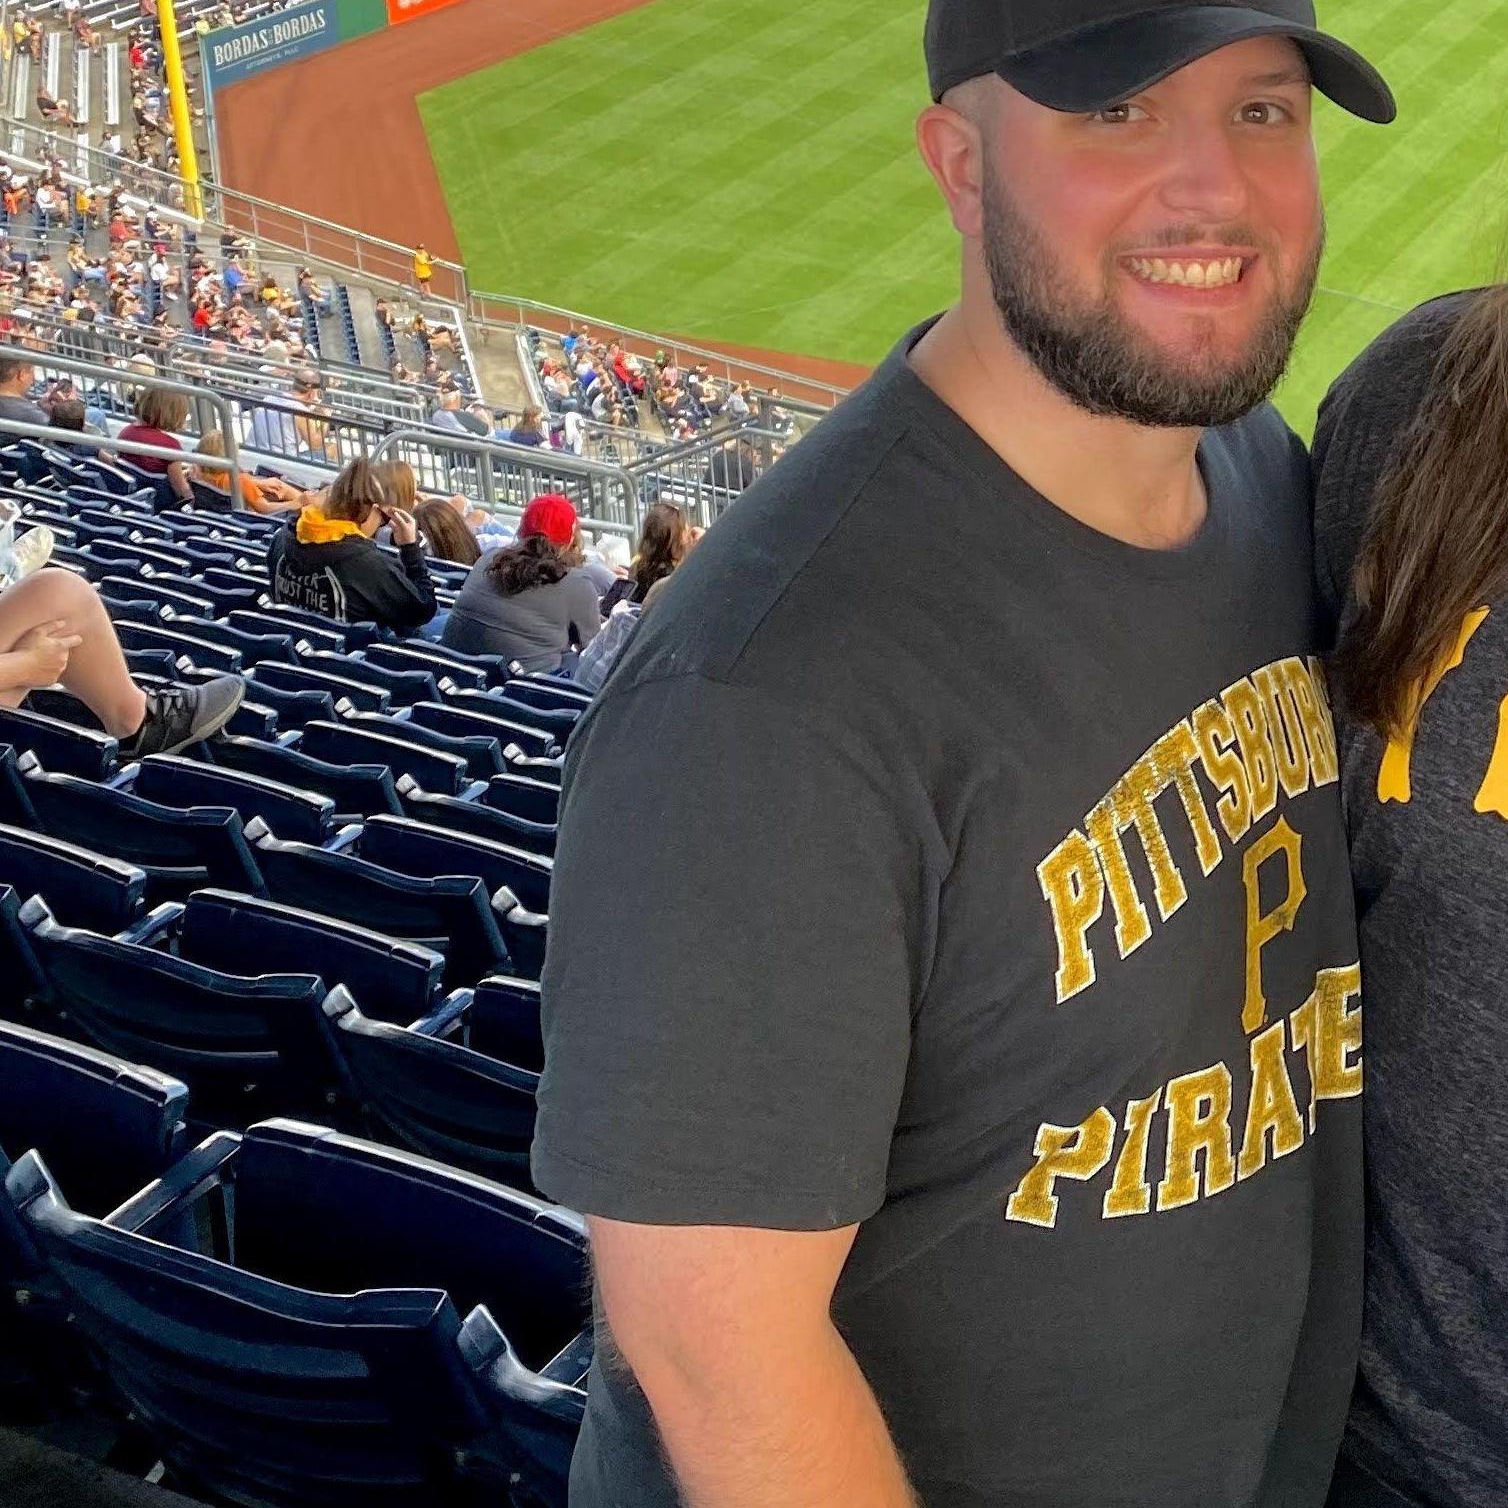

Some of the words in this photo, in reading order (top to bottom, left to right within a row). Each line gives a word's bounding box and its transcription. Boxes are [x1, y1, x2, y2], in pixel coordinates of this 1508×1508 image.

[213, 28, 269, 66] BORDAS
[273, 8, 326, 45] BORDAS
[1036, 655, 1339, 1004] PITTSBUR
[1241, 813, 1306, 1034] P
